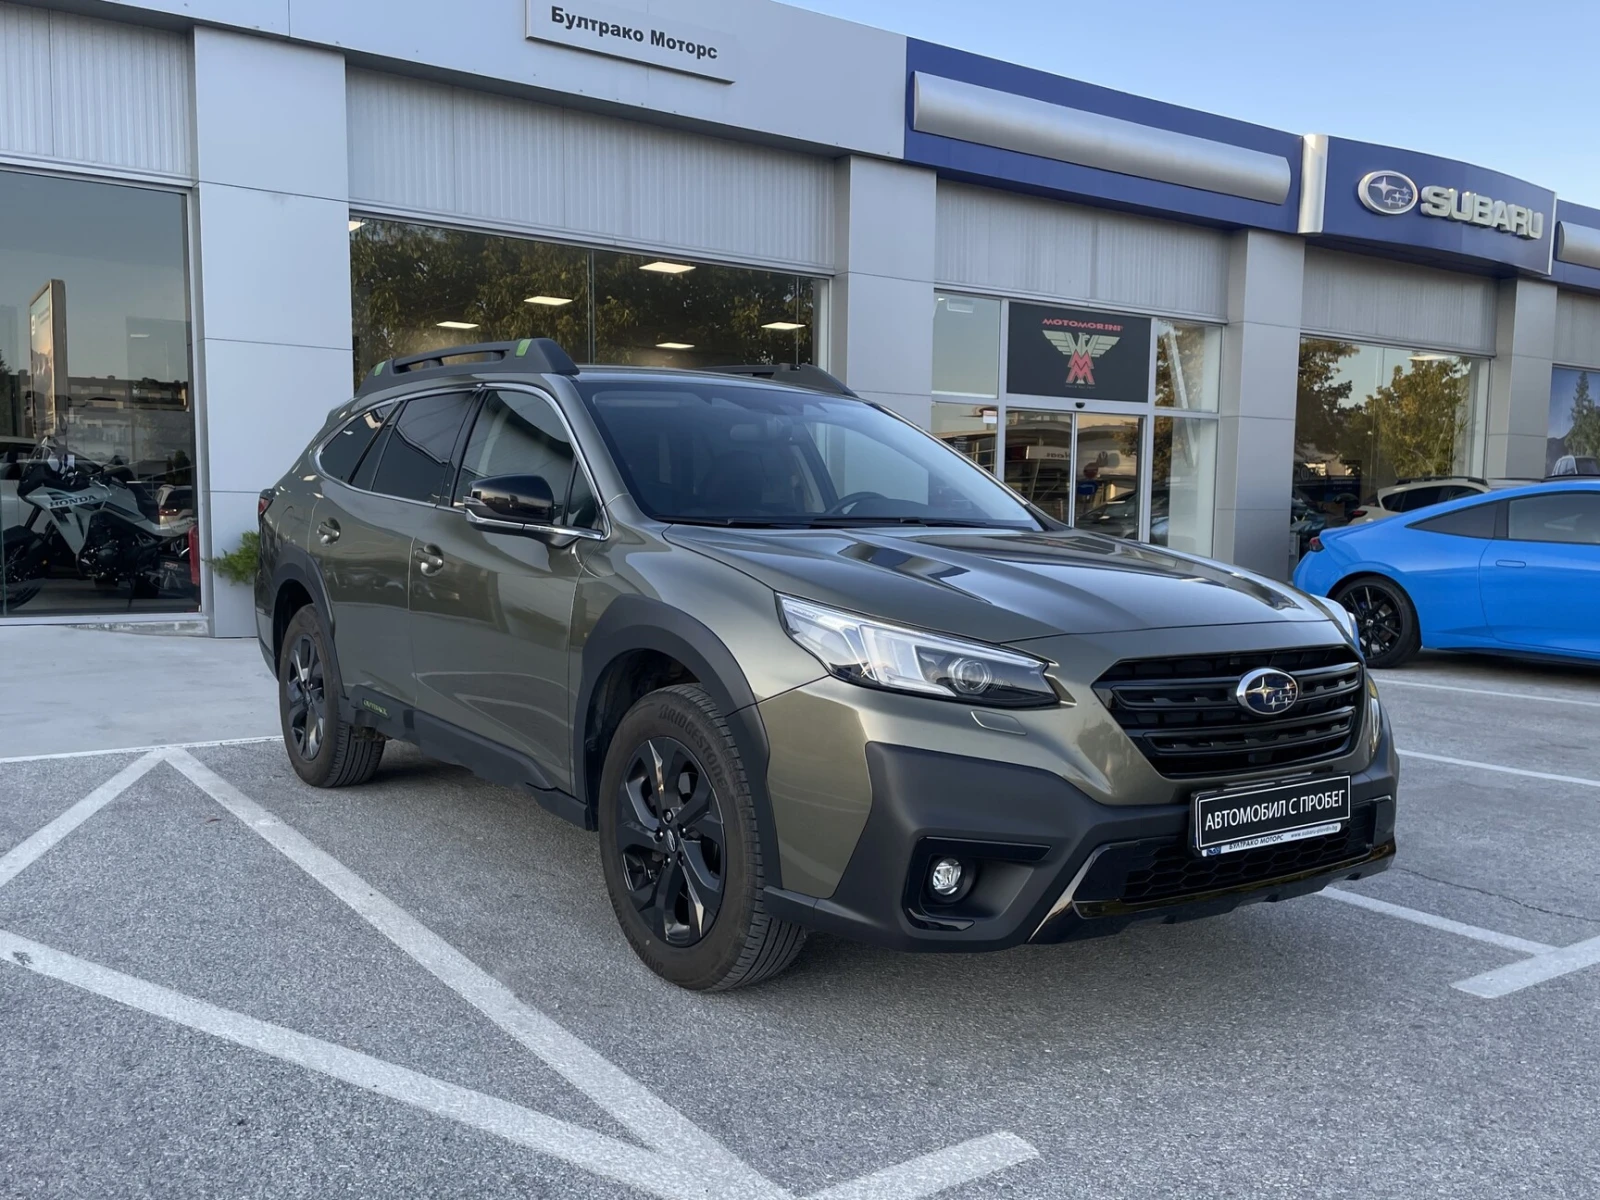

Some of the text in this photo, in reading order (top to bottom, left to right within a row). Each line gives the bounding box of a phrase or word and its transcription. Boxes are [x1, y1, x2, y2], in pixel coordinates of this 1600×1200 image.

[551, 6, 718, 59] Бултрако Моторс
[1420, 185, 1544, 240] SUBARU
[50, 495, 97, 507] HONDA
[1205, 790, 1345, 831] АВТОМОБИЛ С ПРОБЕГ
[1229, 834, 1284, 850] БУЛТРАКО МОТОРС
